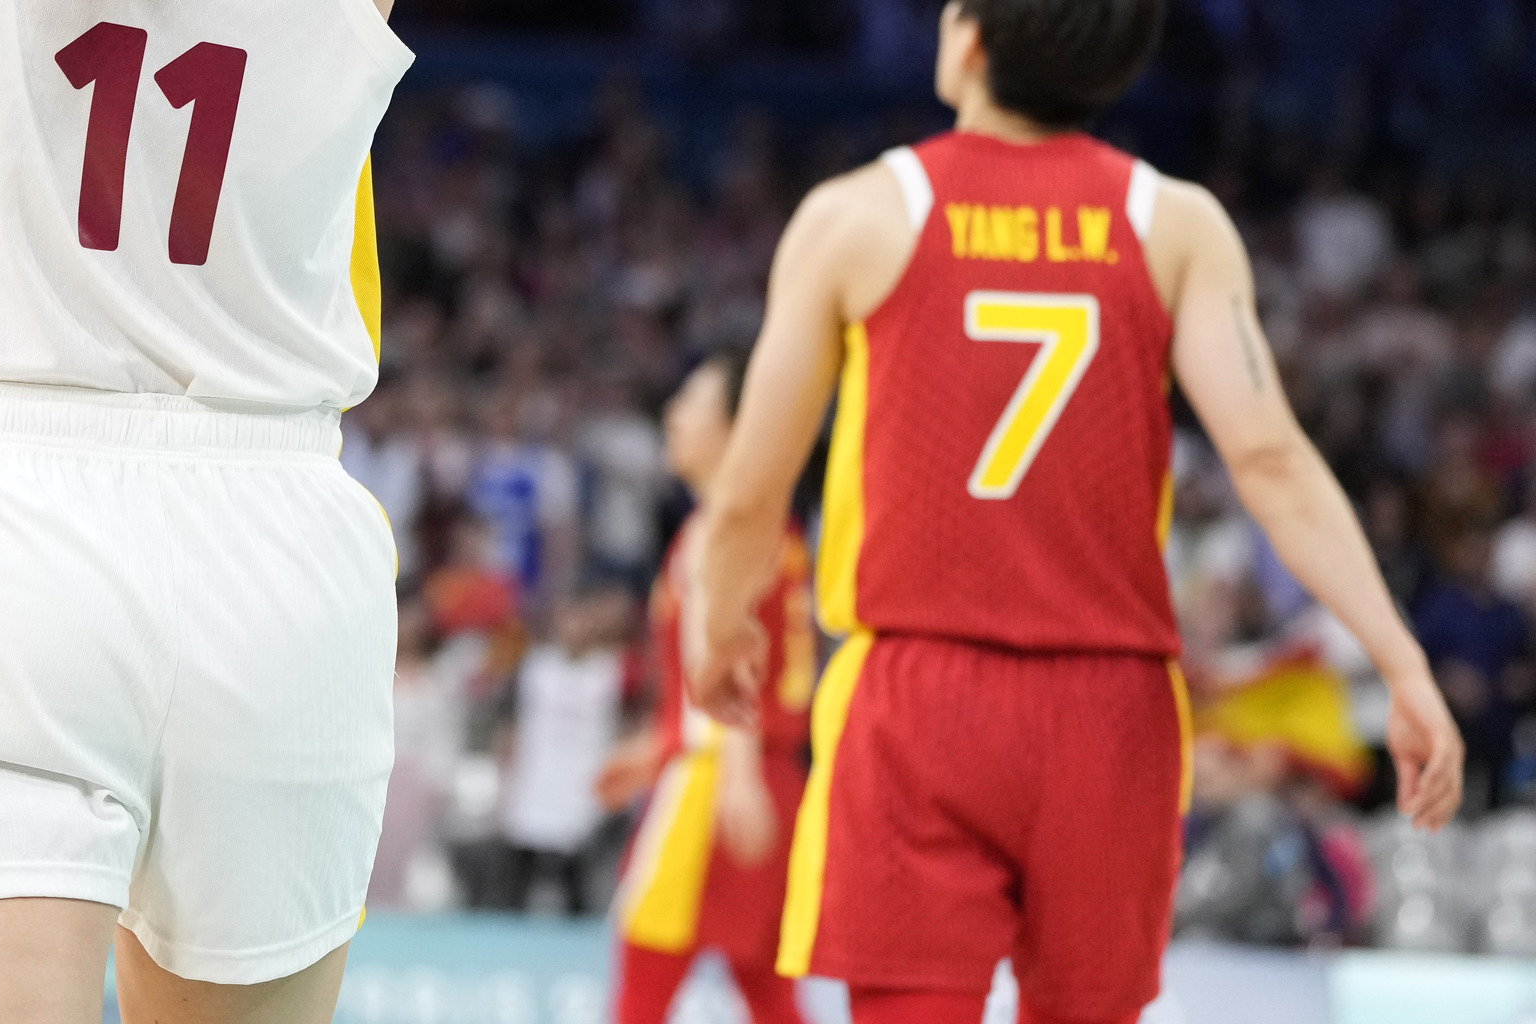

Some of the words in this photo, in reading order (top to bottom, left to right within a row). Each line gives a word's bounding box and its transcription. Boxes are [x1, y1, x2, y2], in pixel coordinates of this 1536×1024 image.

[55, 21, 247, 266] 11
[944, 202, 1039, 262] YANG
[965, 289, 1101, 500] 7
